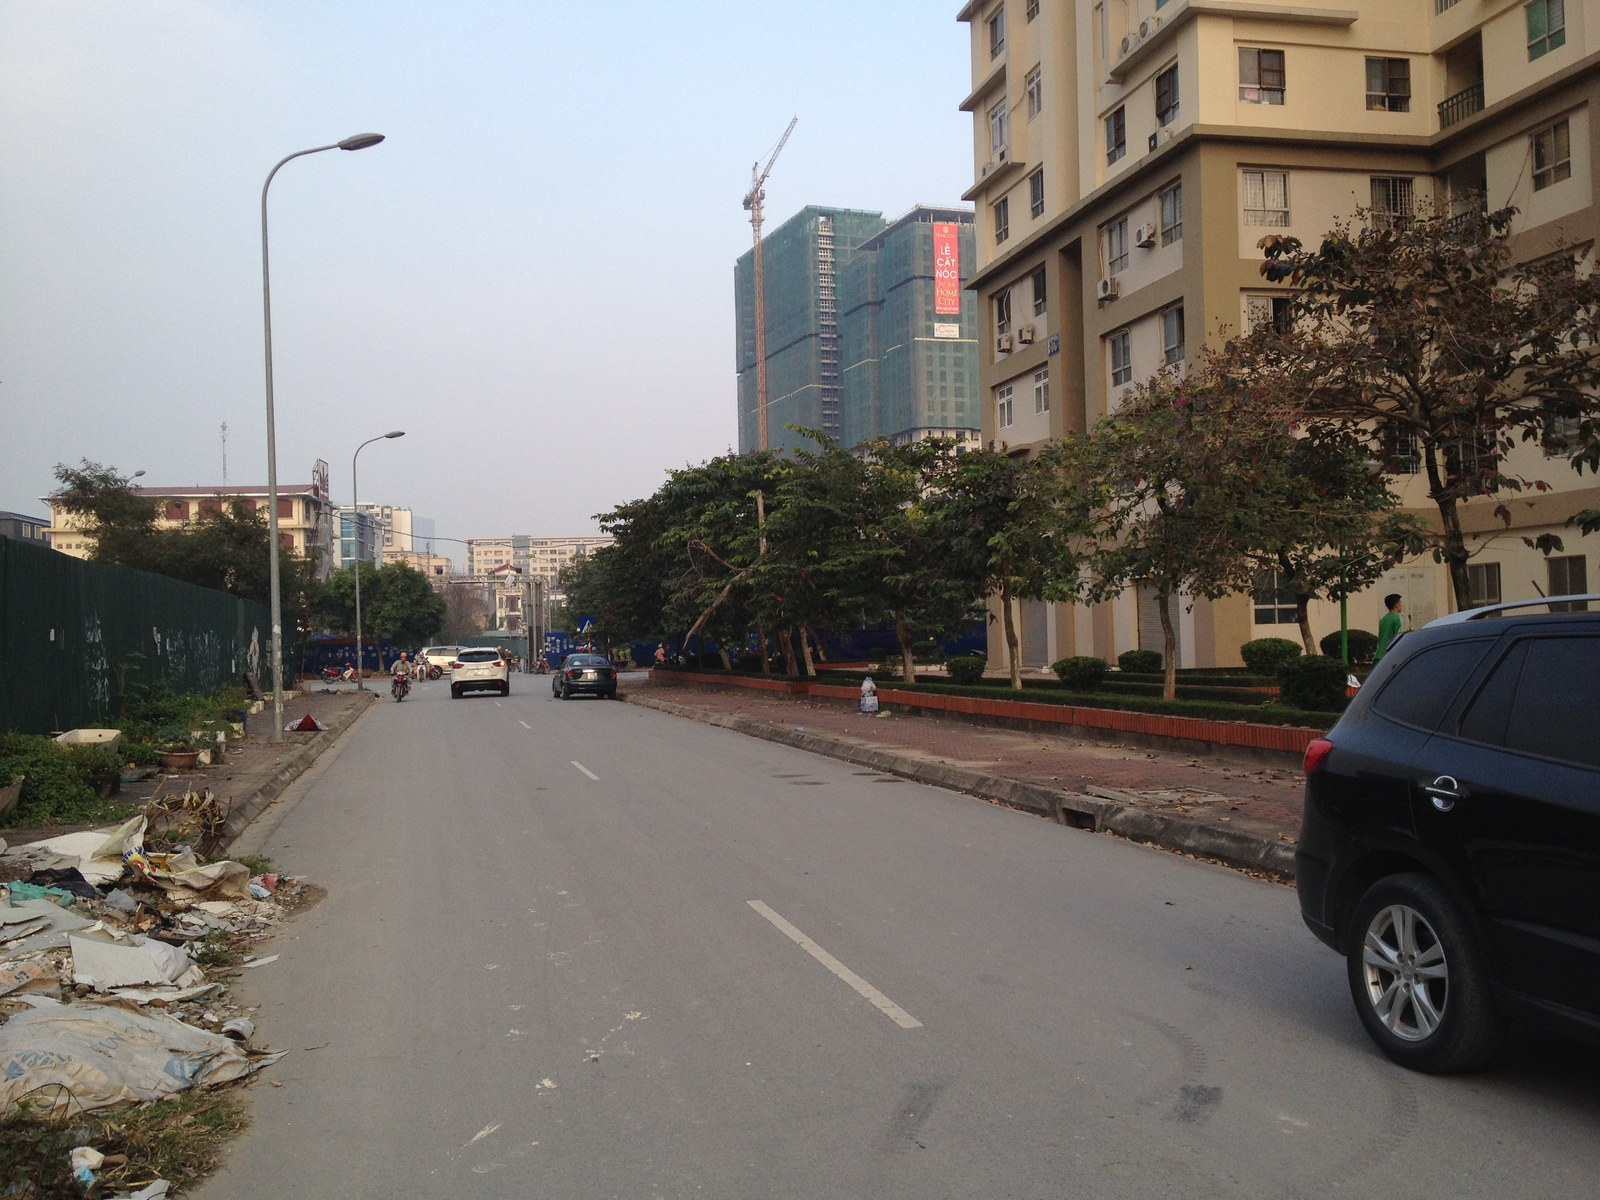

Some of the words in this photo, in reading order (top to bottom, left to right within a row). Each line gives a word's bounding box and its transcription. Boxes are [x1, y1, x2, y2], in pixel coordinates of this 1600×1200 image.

[936, 256, 956, 267] CẤT
[935, 267, 957, 279] NÓC
[936, 288, 958, 297] HOME
[938, 298, 956, 306] CITY
